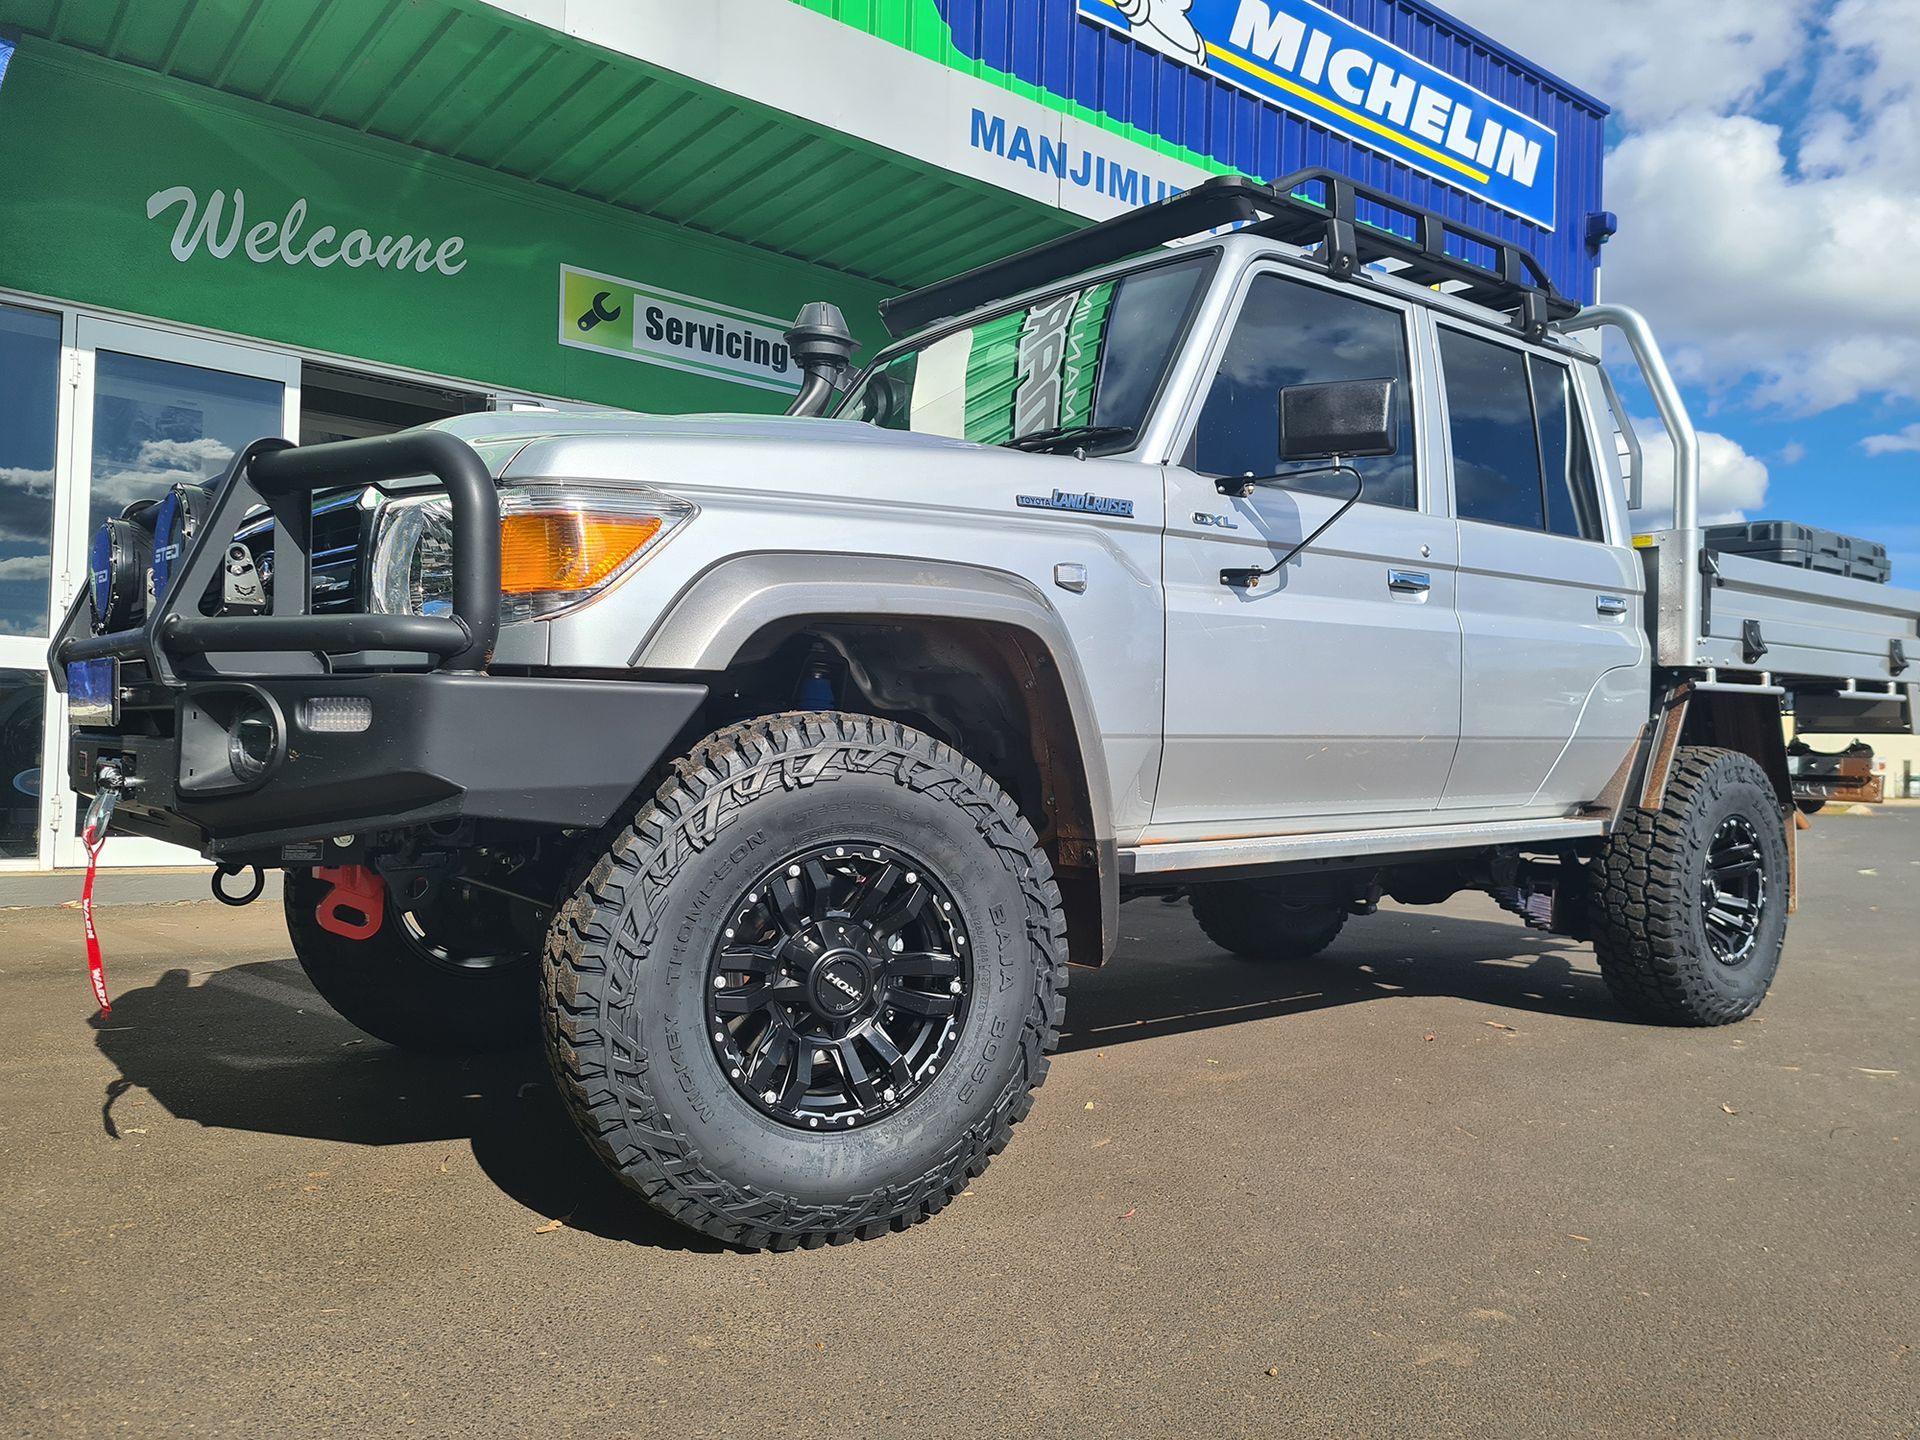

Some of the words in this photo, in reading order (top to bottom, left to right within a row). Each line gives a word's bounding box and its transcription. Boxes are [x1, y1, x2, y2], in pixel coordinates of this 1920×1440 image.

[1229, 0, 1542, 188] MICHELIN
[971, 107, 1185, 206] MANJIMU
[146, 185, 468, 276] Welcome
[645, 306, 789, 374] Servicing
[1019, 496, 1051, 506] TOYOTA
[1191, 512, 1238, 530] GXL
[83, 898, 95, 940] WARN
[988, 902, 1014, 994] BAJA
[91, 967, 109, 1007] WARN
[825, 972, 859, 998] ROH
[664, 1012, 715, 1126] MICKEY
[957, 1014, 1009, 1105] BOSS
